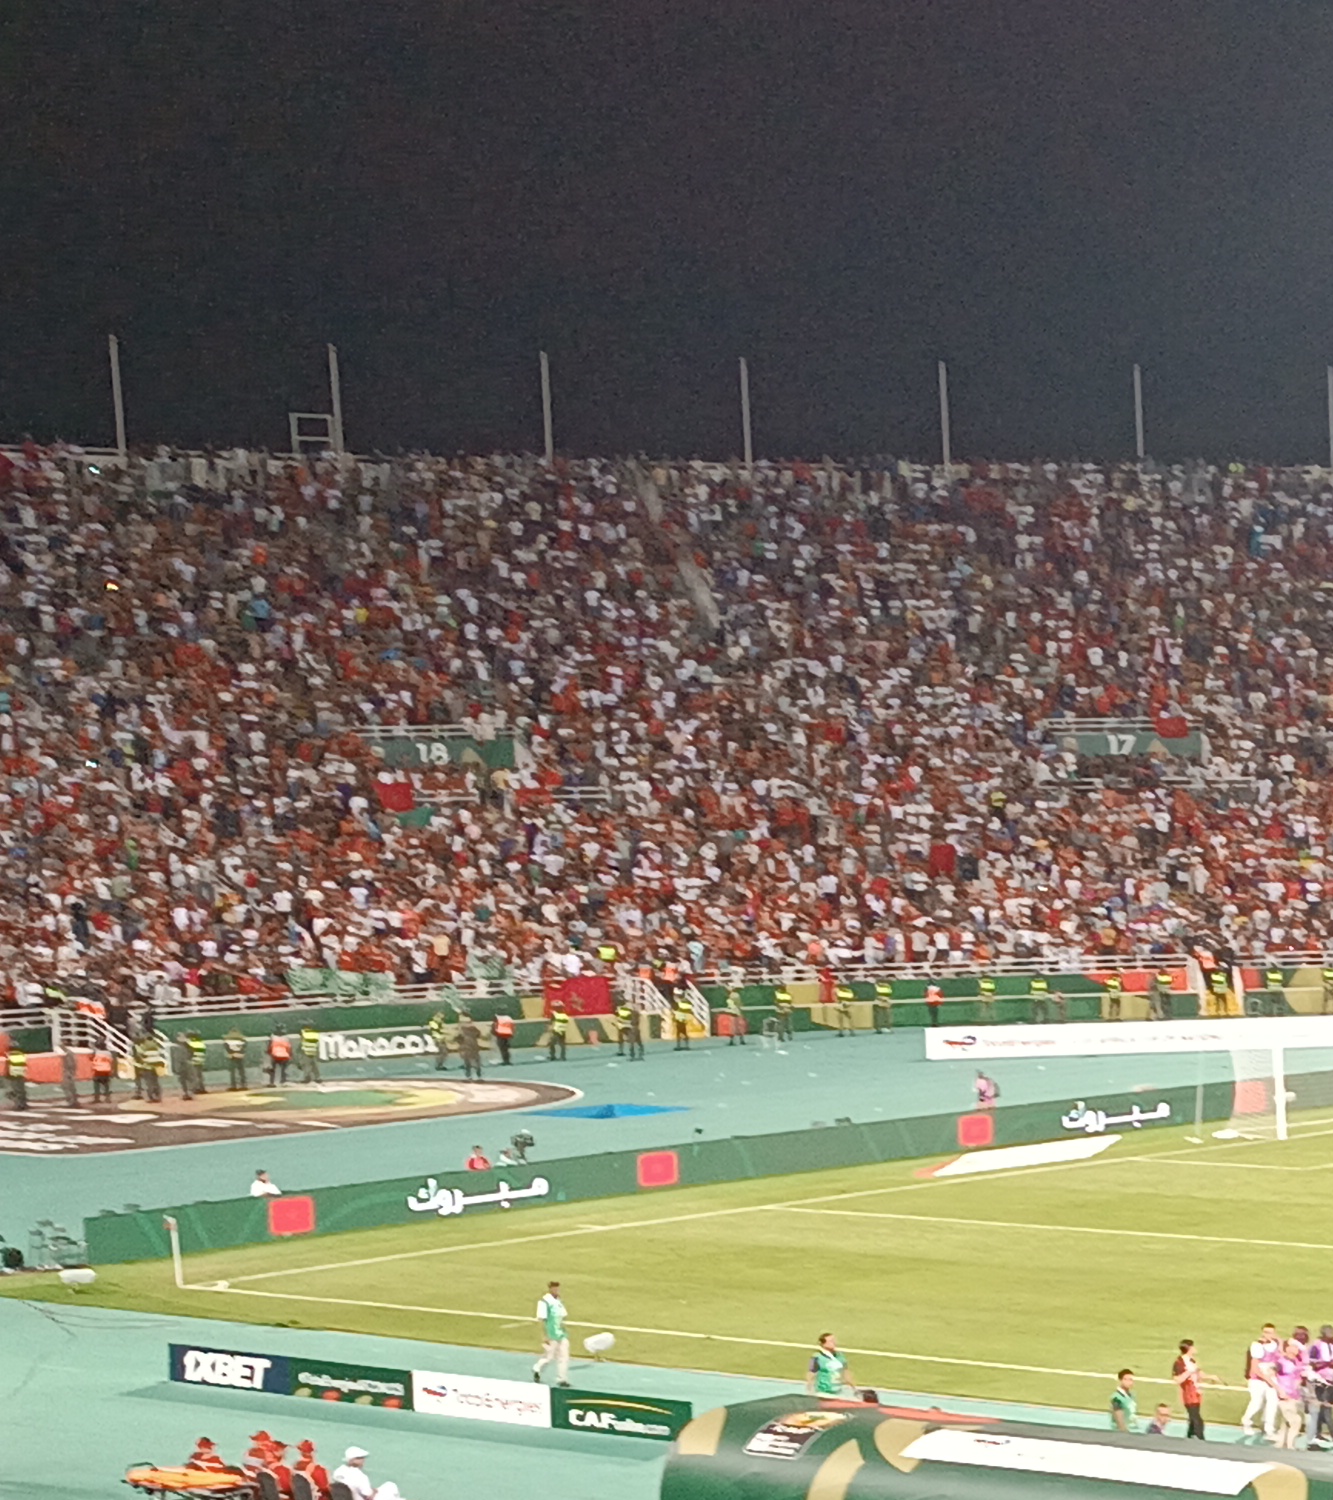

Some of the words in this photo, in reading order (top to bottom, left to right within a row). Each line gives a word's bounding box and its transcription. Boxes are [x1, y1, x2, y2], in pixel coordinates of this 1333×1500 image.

[415, 742, 451, 765] 18
[1106, 734, 1137, 755] 17
[183, 1350, 272, 1390] 1XBET
